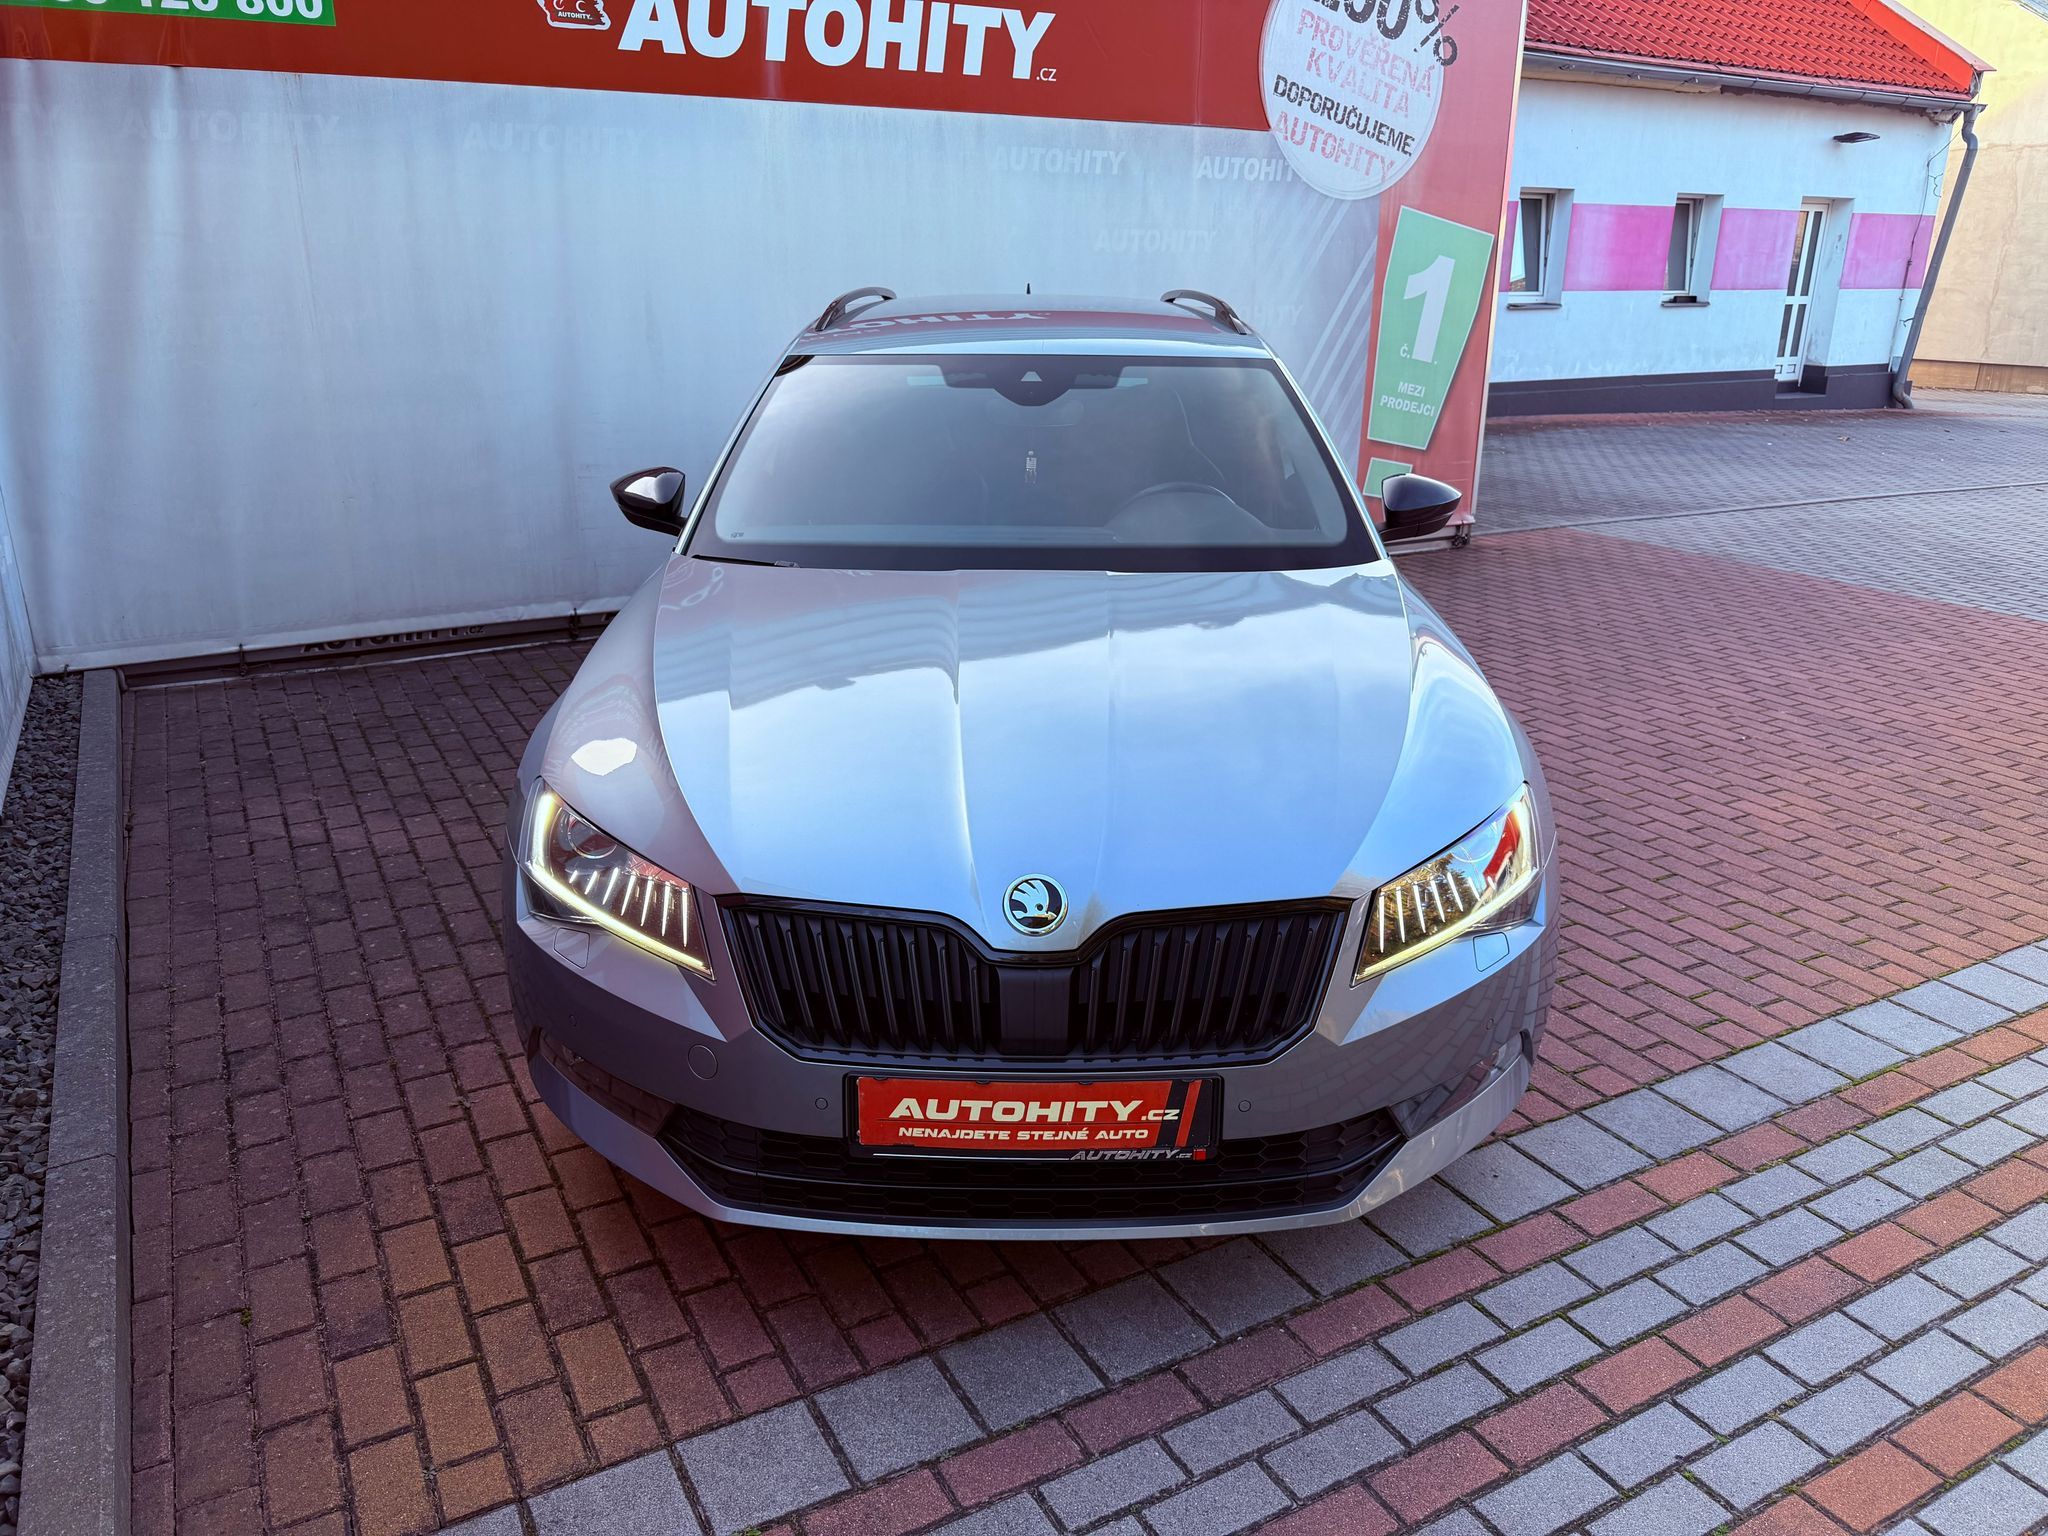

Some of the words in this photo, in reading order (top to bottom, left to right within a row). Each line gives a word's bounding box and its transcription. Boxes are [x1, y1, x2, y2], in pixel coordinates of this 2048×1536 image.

[1305, 47, 1409, 119] KVALITA
[1273, 74, 1415, 157] DOPORUČUJEME
[1270, 111, 1395, 183] AUTOHITY
[992, 146, 1126, 176] AUTOHITY
[1197, 156, 1293, 182] AUTOHIT
[1092, 228, 1217, 254] AUTOHITY
[1398, 381, 1425, 397] MEZI
[1380, 395, 1435, 417] PRODEJCI
[898, 1127, 1010, 1140] NENAJDETE
[1016, 1127, 1089, 1141] STEJNÉ
[1094, 1129, 1149, 1139] AUTO
